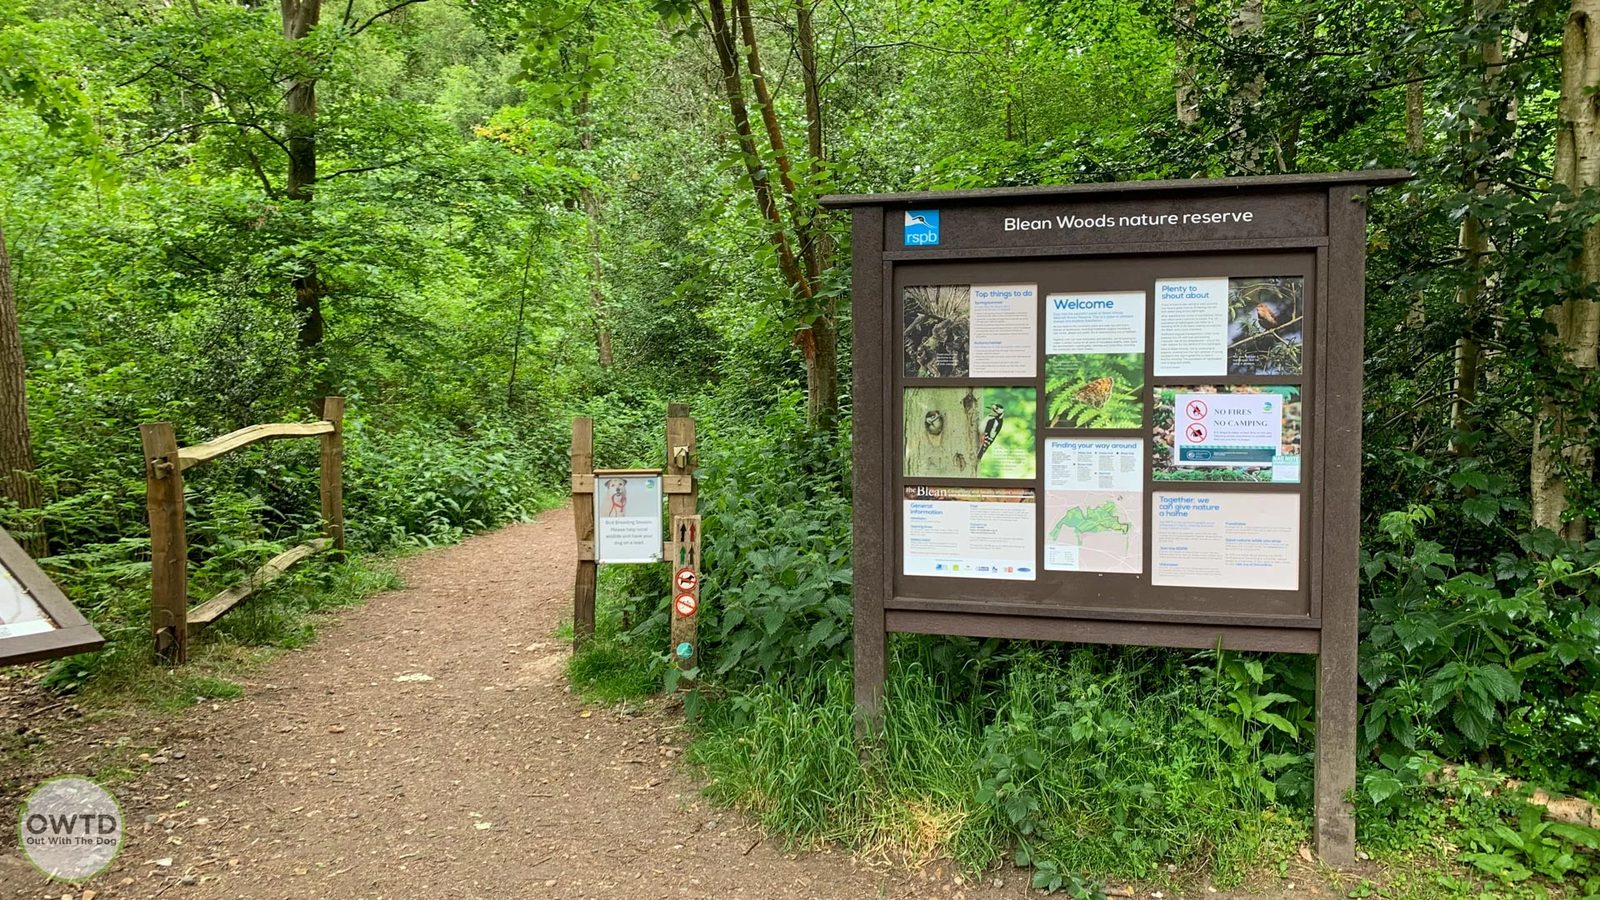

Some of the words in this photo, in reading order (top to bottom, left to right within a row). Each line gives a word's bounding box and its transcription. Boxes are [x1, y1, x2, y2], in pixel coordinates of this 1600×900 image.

[1004, 216, 1052, 231] Blean
[1056, 214, 1115, 229] Woods
[1119, 212, 1178, 227] nature
[1182, 210, 1254, 224] reserve
[906, 231, 938, 245] rspb
[1161, 285, 1187, 293] Plenty
[975, 290, 988, 298] Top
[990, 290, 1012, 299] things
[1161, 292, 1184, 300] shout
[1053, 298, 1114, 310] Welcome
[1228, 408, 1252, 416] FIRES
[1051, 442, 1077, 450] Finding
[917, 486, 947, 497] Blean
[1175, 503, 1191, 511] give
